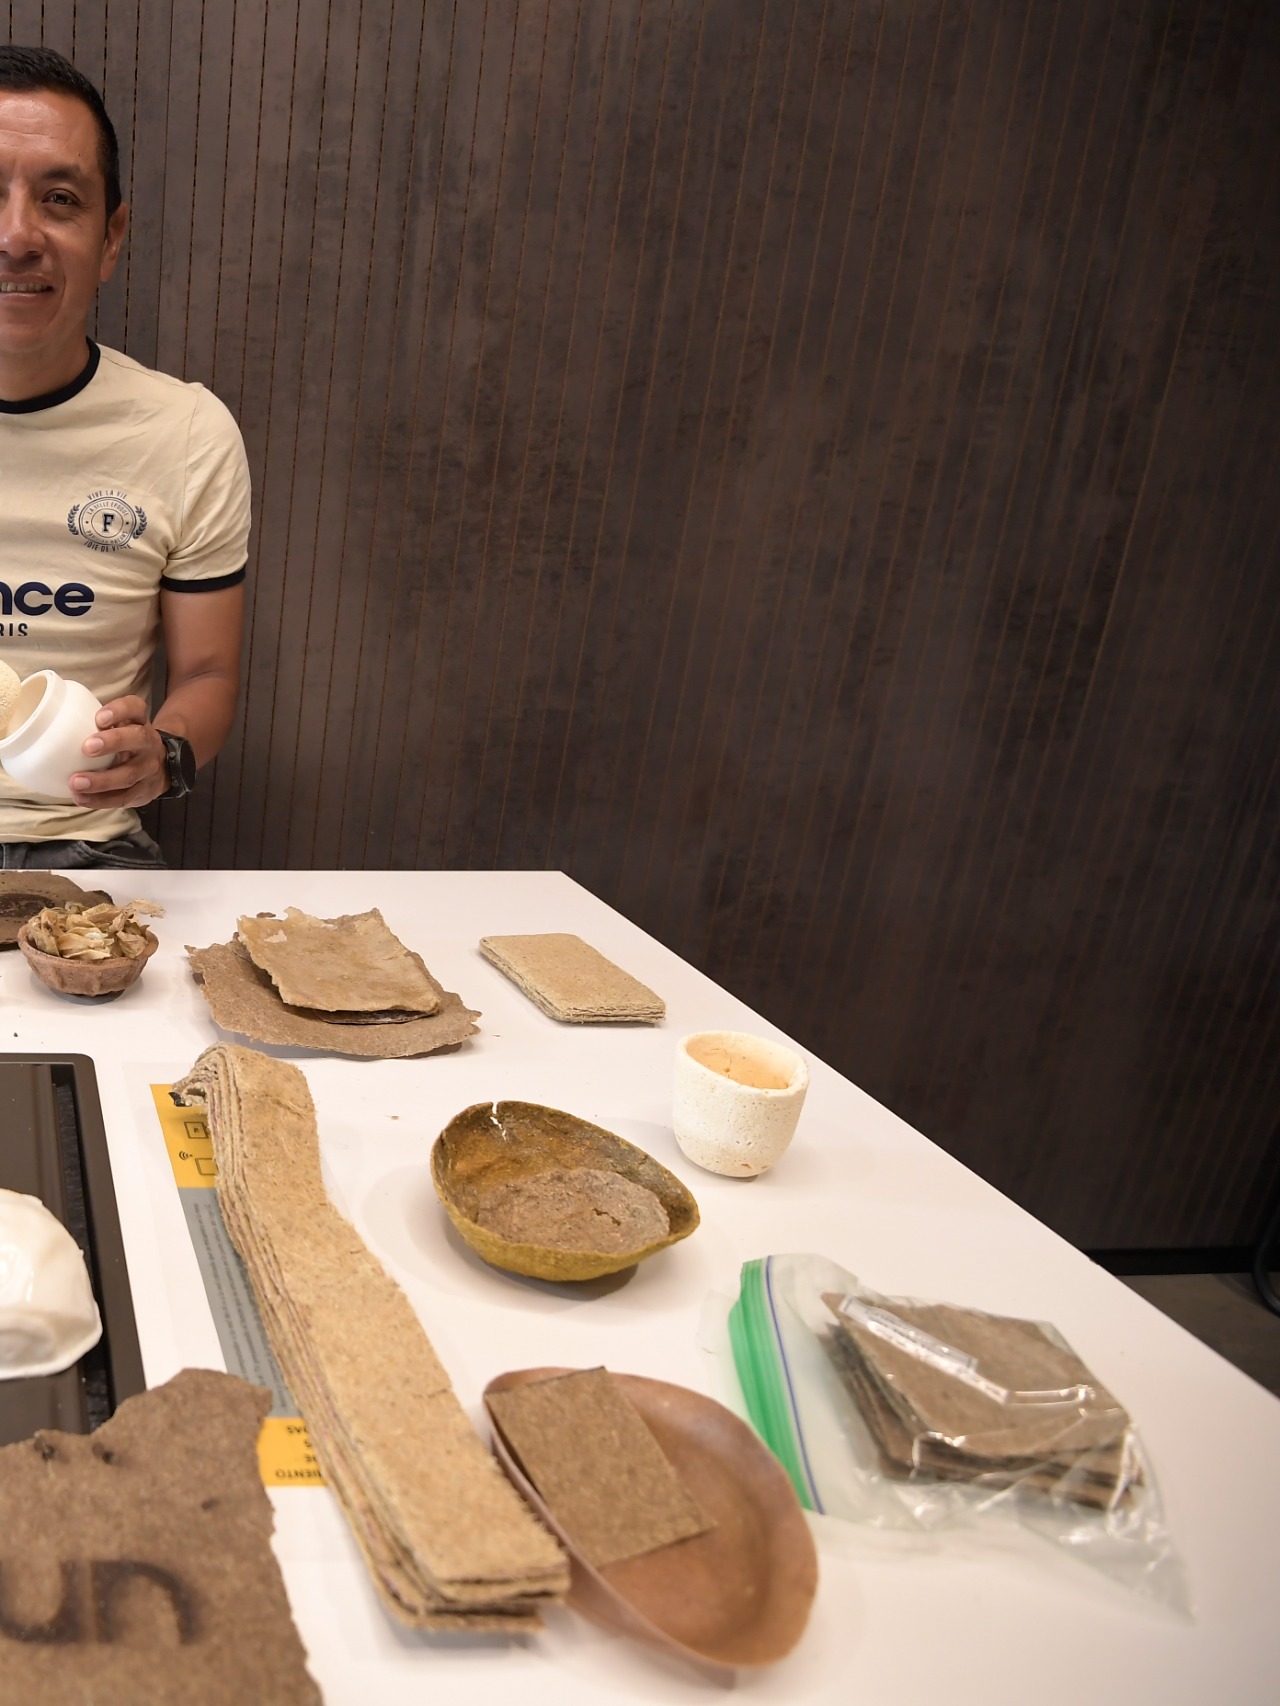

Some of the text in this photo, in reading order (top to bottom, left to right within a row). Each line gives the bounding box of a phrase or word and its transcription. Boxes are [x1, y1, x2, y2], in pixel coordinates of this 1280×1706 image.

[87, 490, 102, 500] VIVE
[117, 490, 128, 499] VIE
[102, 513, 115, 532] F
[84, 540, 99, 551] JOIE
